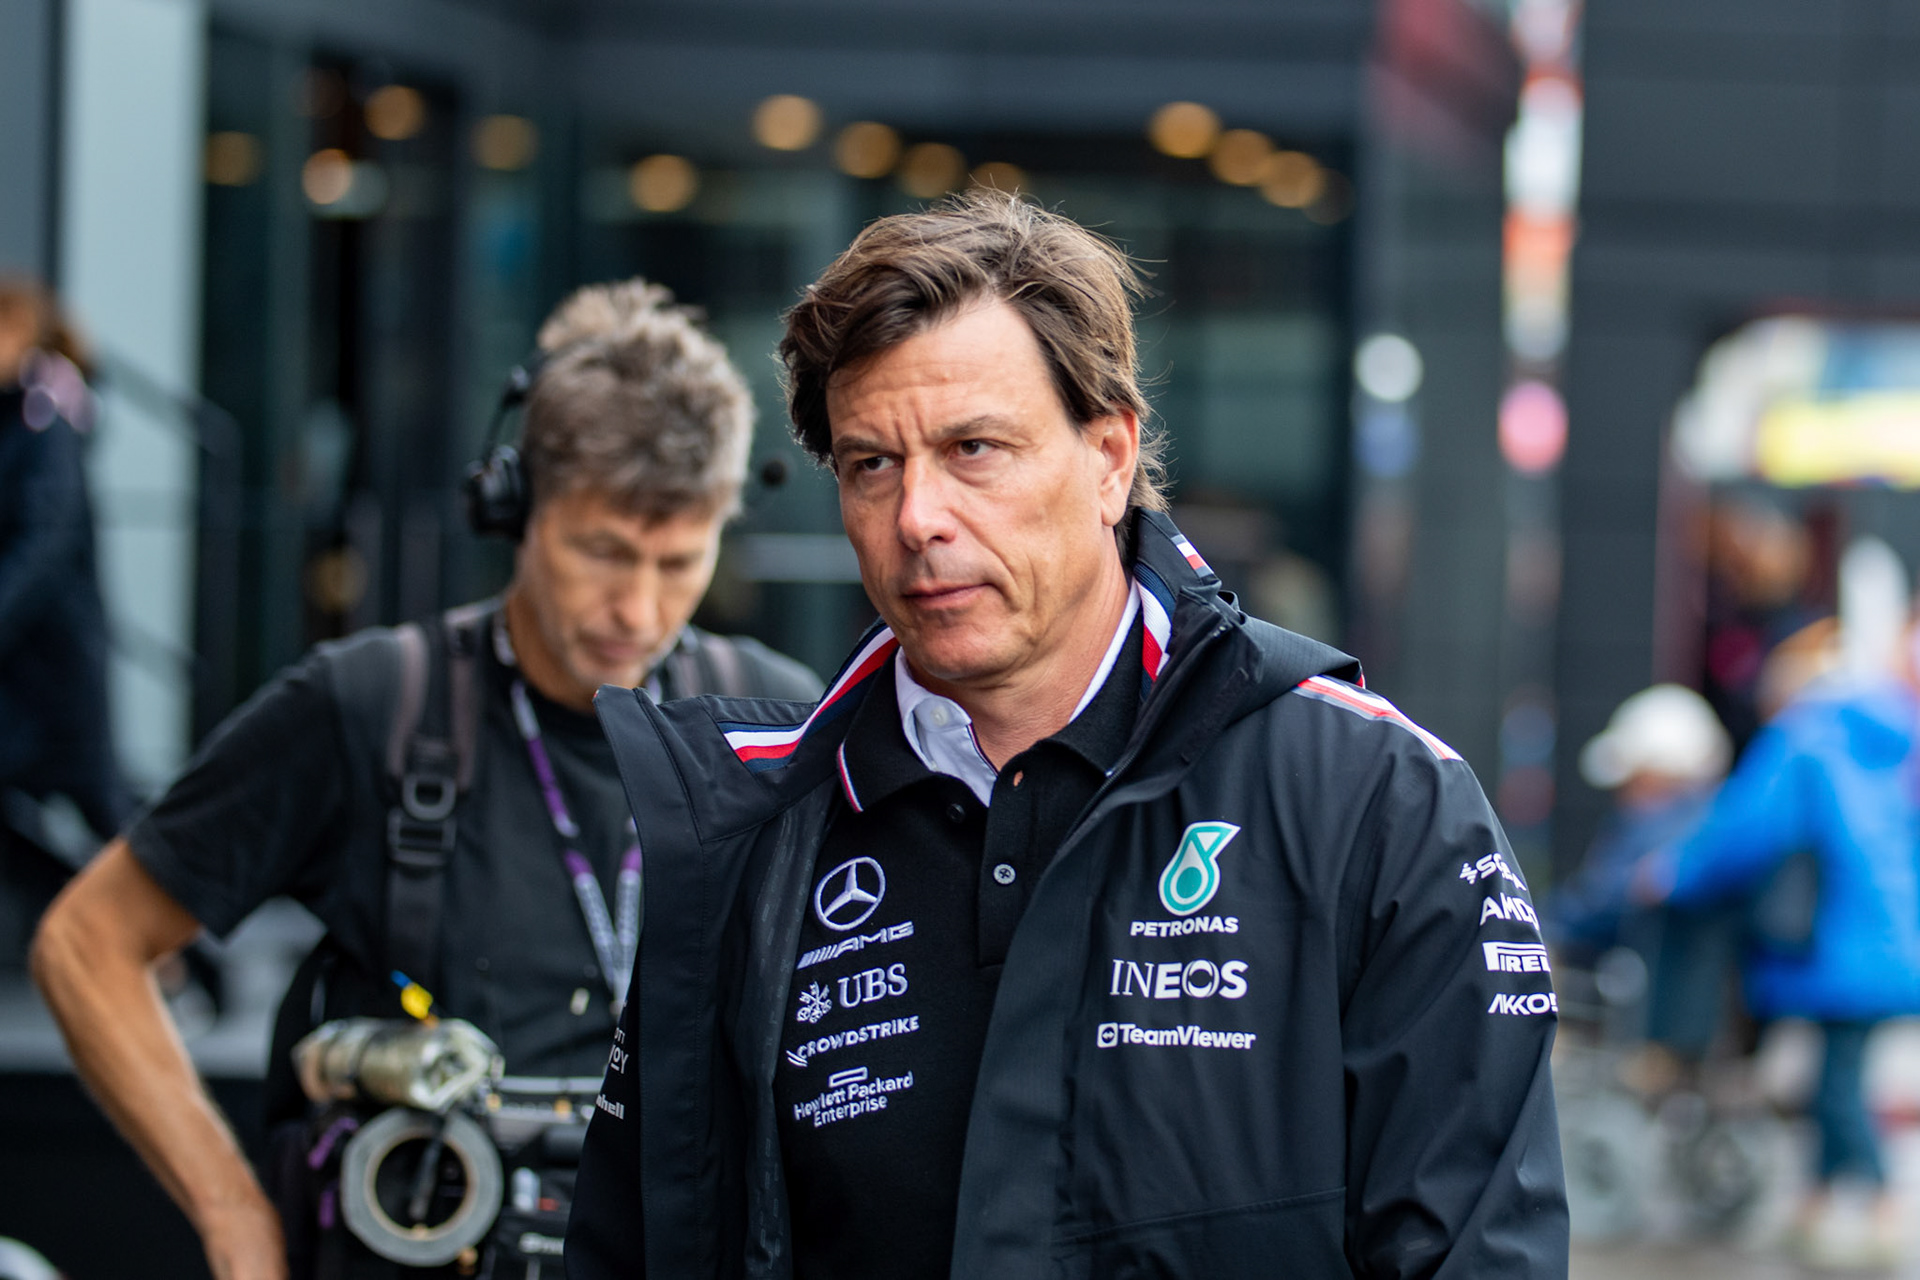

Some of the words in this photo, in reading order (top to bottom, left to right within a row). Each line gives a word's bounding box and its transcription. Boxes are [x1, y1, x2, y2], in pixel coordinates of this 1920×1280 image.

[1130, 916, 1239, 938] PETRONAS
[1480, 892, 1534, 926] AMD
[833, 920, 914, 958] AMG
[837, 963, 909, 1008] UBS
[1110, 959, 1249, 999] INEOS
[797, 1015, 920, 1060] CROWDSTRIKE
[1119, 1023, 1257, 1050] TeamViewer
[793, 1087, 847, 1120] Hewlett
[847, 1070, 914, 1100] Packard
[814, 1095, 888, 1128] Enterprise
